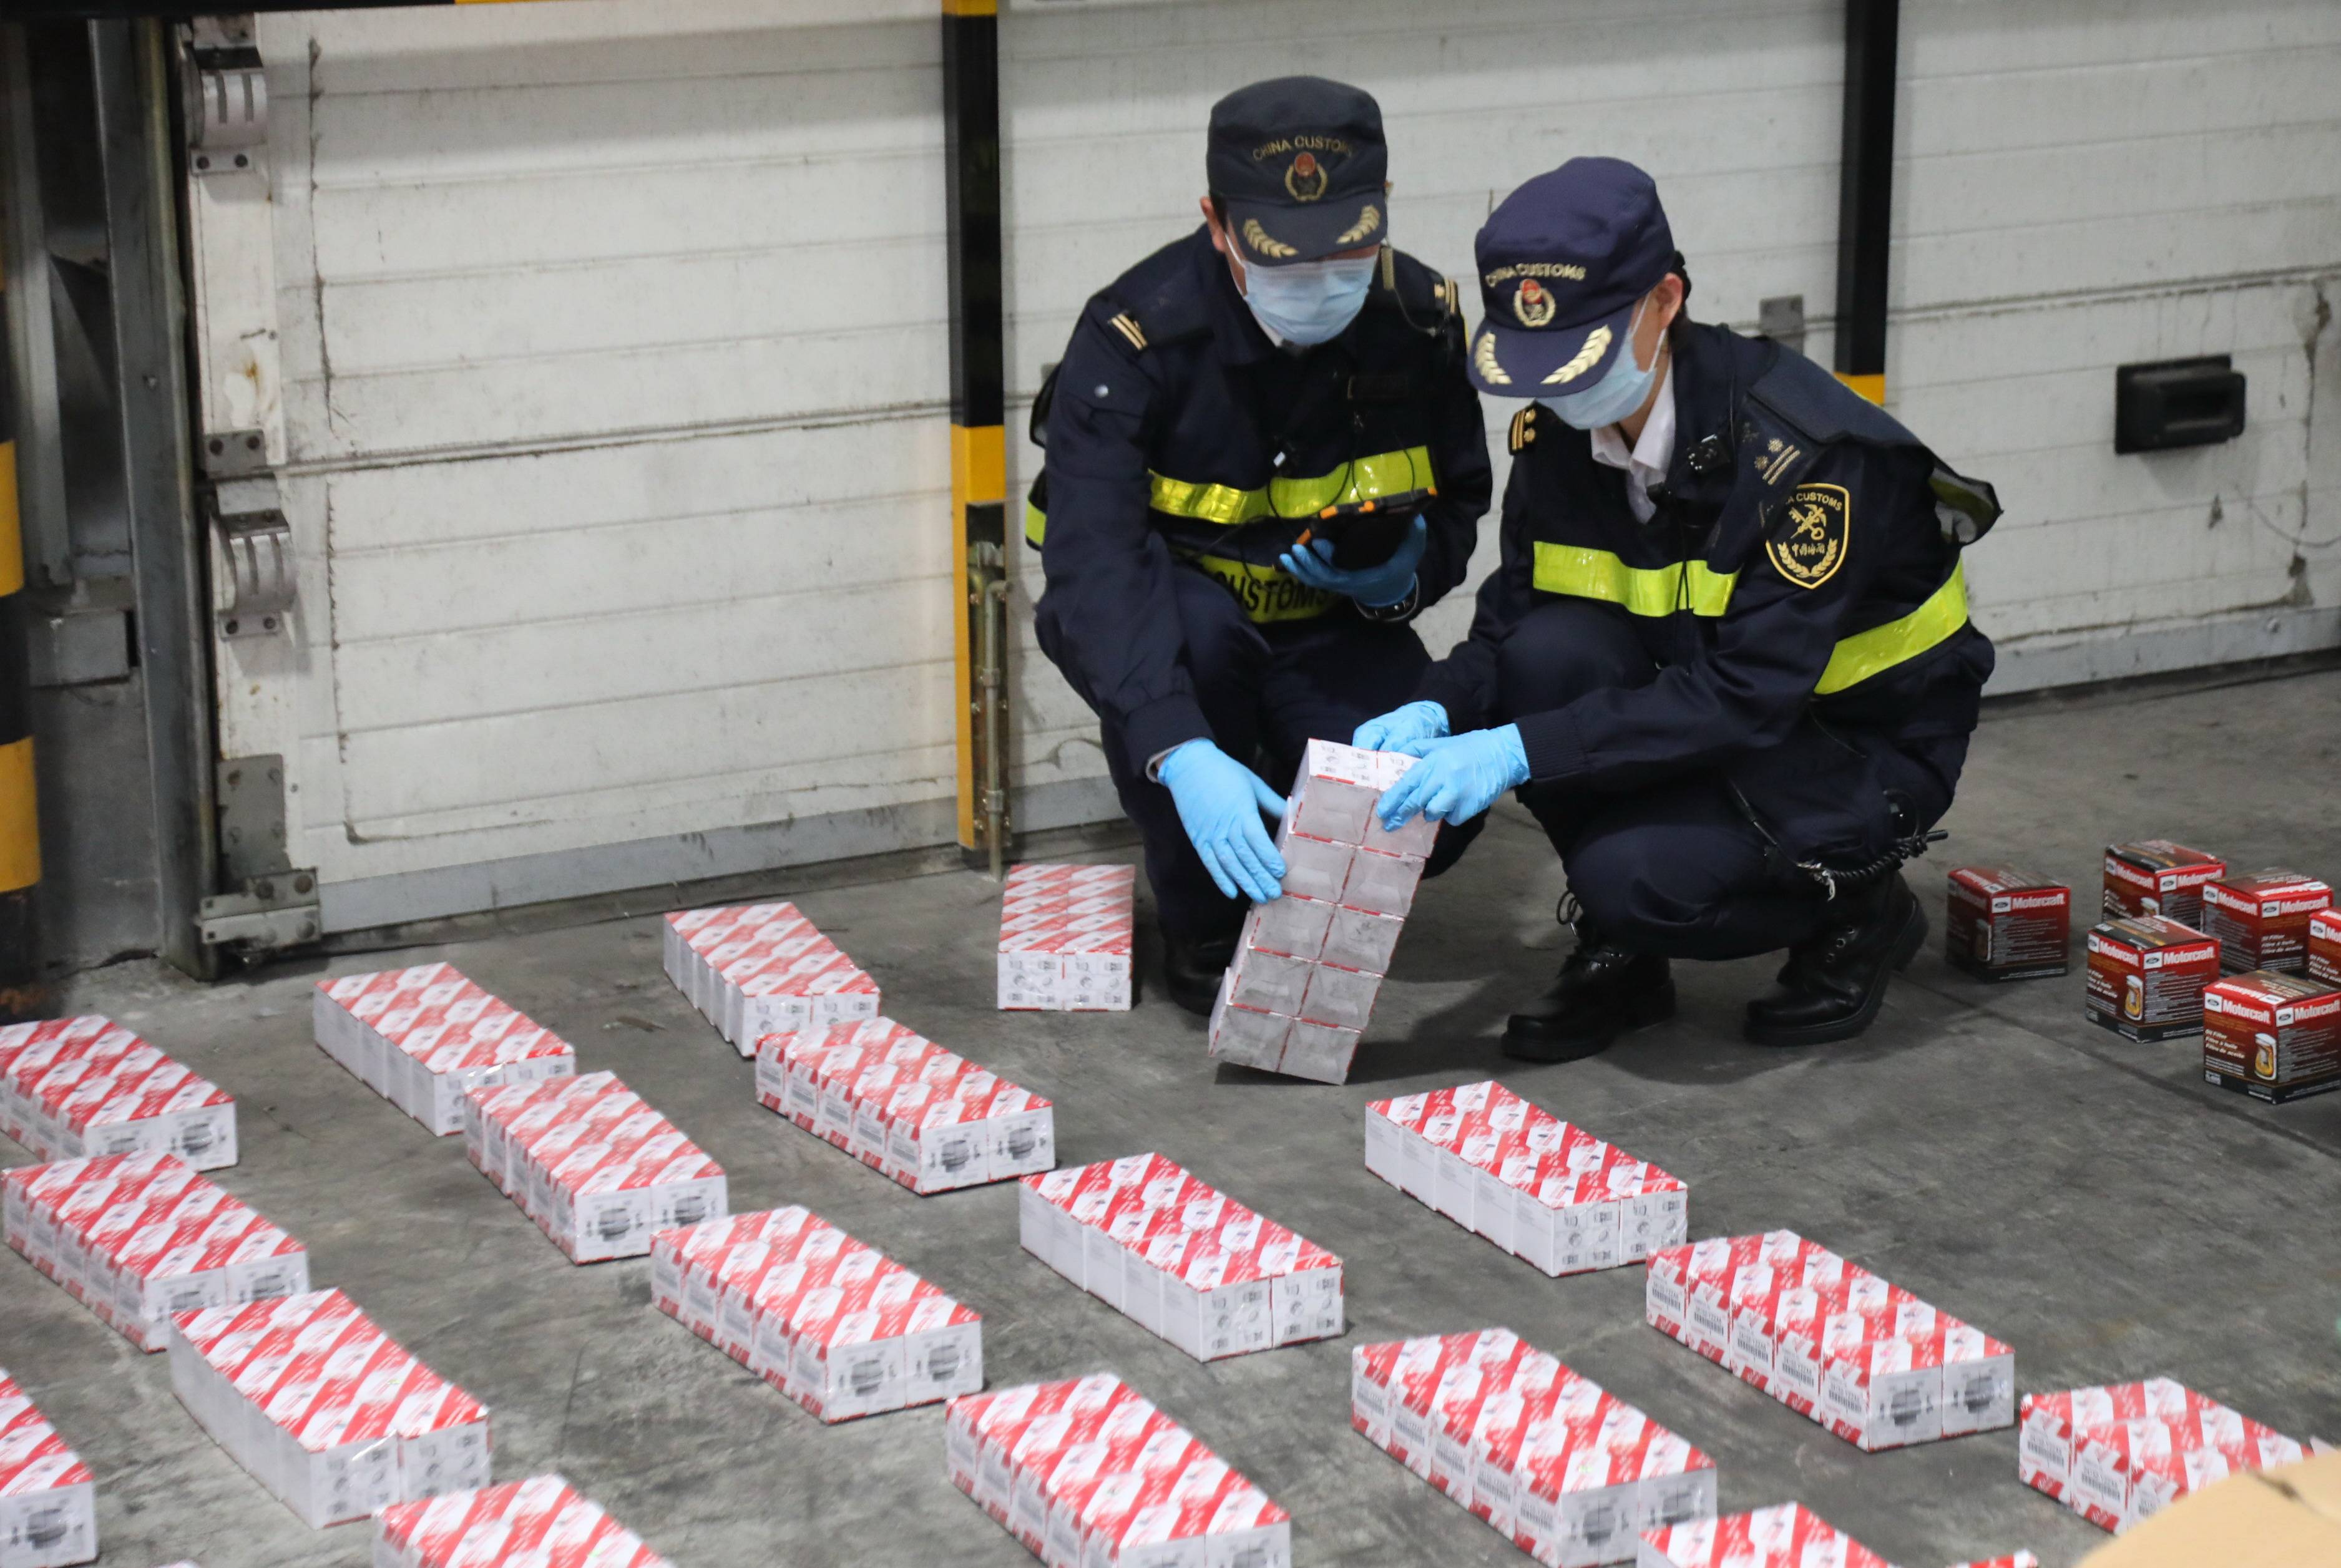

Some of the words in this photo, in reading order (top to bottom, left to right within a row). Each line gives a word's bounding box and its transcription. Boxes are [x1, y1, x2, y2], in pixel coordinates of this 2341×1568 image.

[1253, 139, 1293, 161] CHINA
[1485, 266, 1517, 288] CHINA
[1515, 263, 1586, 280] CUSTOMS
[1796, 492, 1843, 511] CUSTOMS
[2012, 893, 2065, 910] Motorcraft
[2280, 895, 2329, 914] Motorcraft
[2099, 940, 2139, 967] Motorcraft
[2163, 946, 2215, 965] Motorcraft
[2222, 999, 2271, 1025] Motorcraft
[2294, 999, 2341, 1021] Motorcraft
